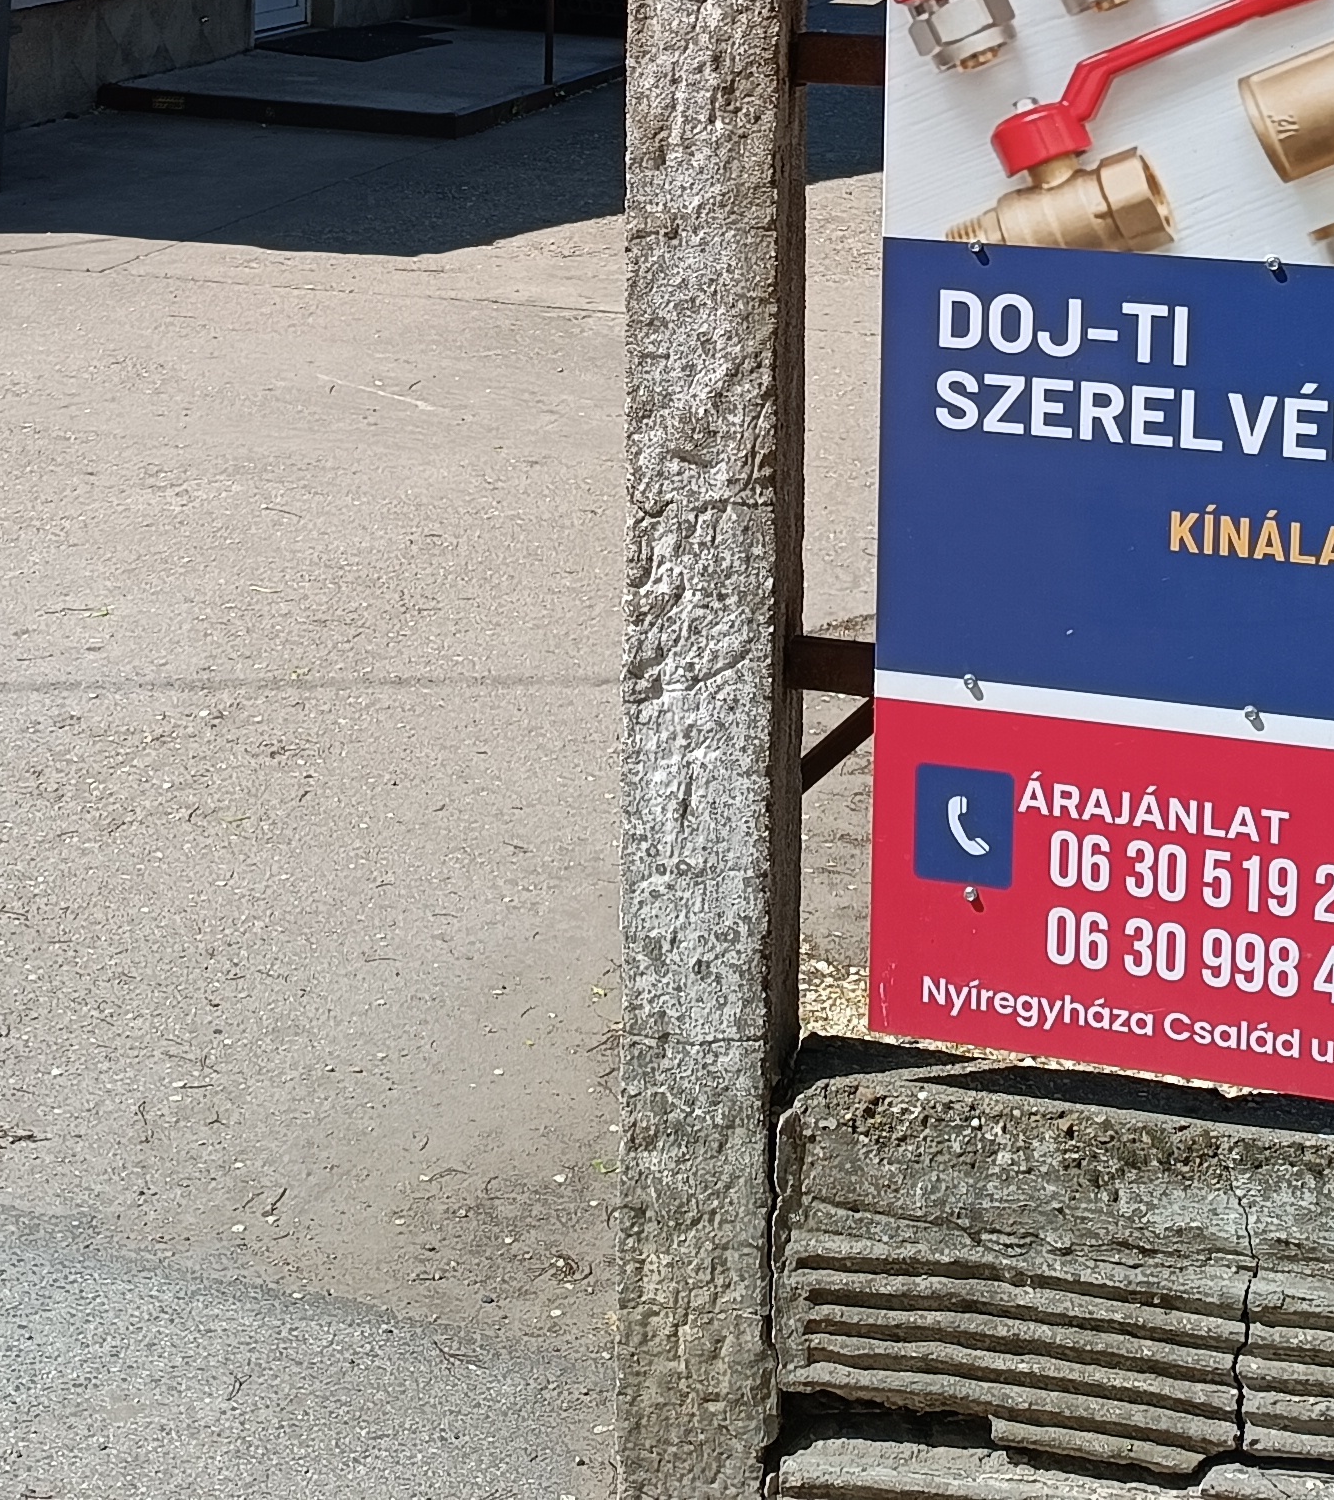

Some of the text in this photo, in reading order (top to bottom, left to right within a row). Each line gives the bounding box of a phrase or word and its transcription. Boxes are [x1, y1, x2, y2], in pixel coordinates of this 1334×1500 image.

[938, 288, 1189, 368] DOJ-TI
[1017, 771, 1290, 846] ÁRAJÁNLAT
[1048, 829, 1111, 893] 06
[1125, 838, 1188, 903] 30
[1202, 848, 1299, 918] 519
[1045, 905, 1110, 971] 06
[1124, 917, 1188, 982] 30
[1201, 927, 1300, 999] 998
[921, 975, 1156, 1038] Nyíregyháza
[1163, 1010, 1301, 1060] Család
